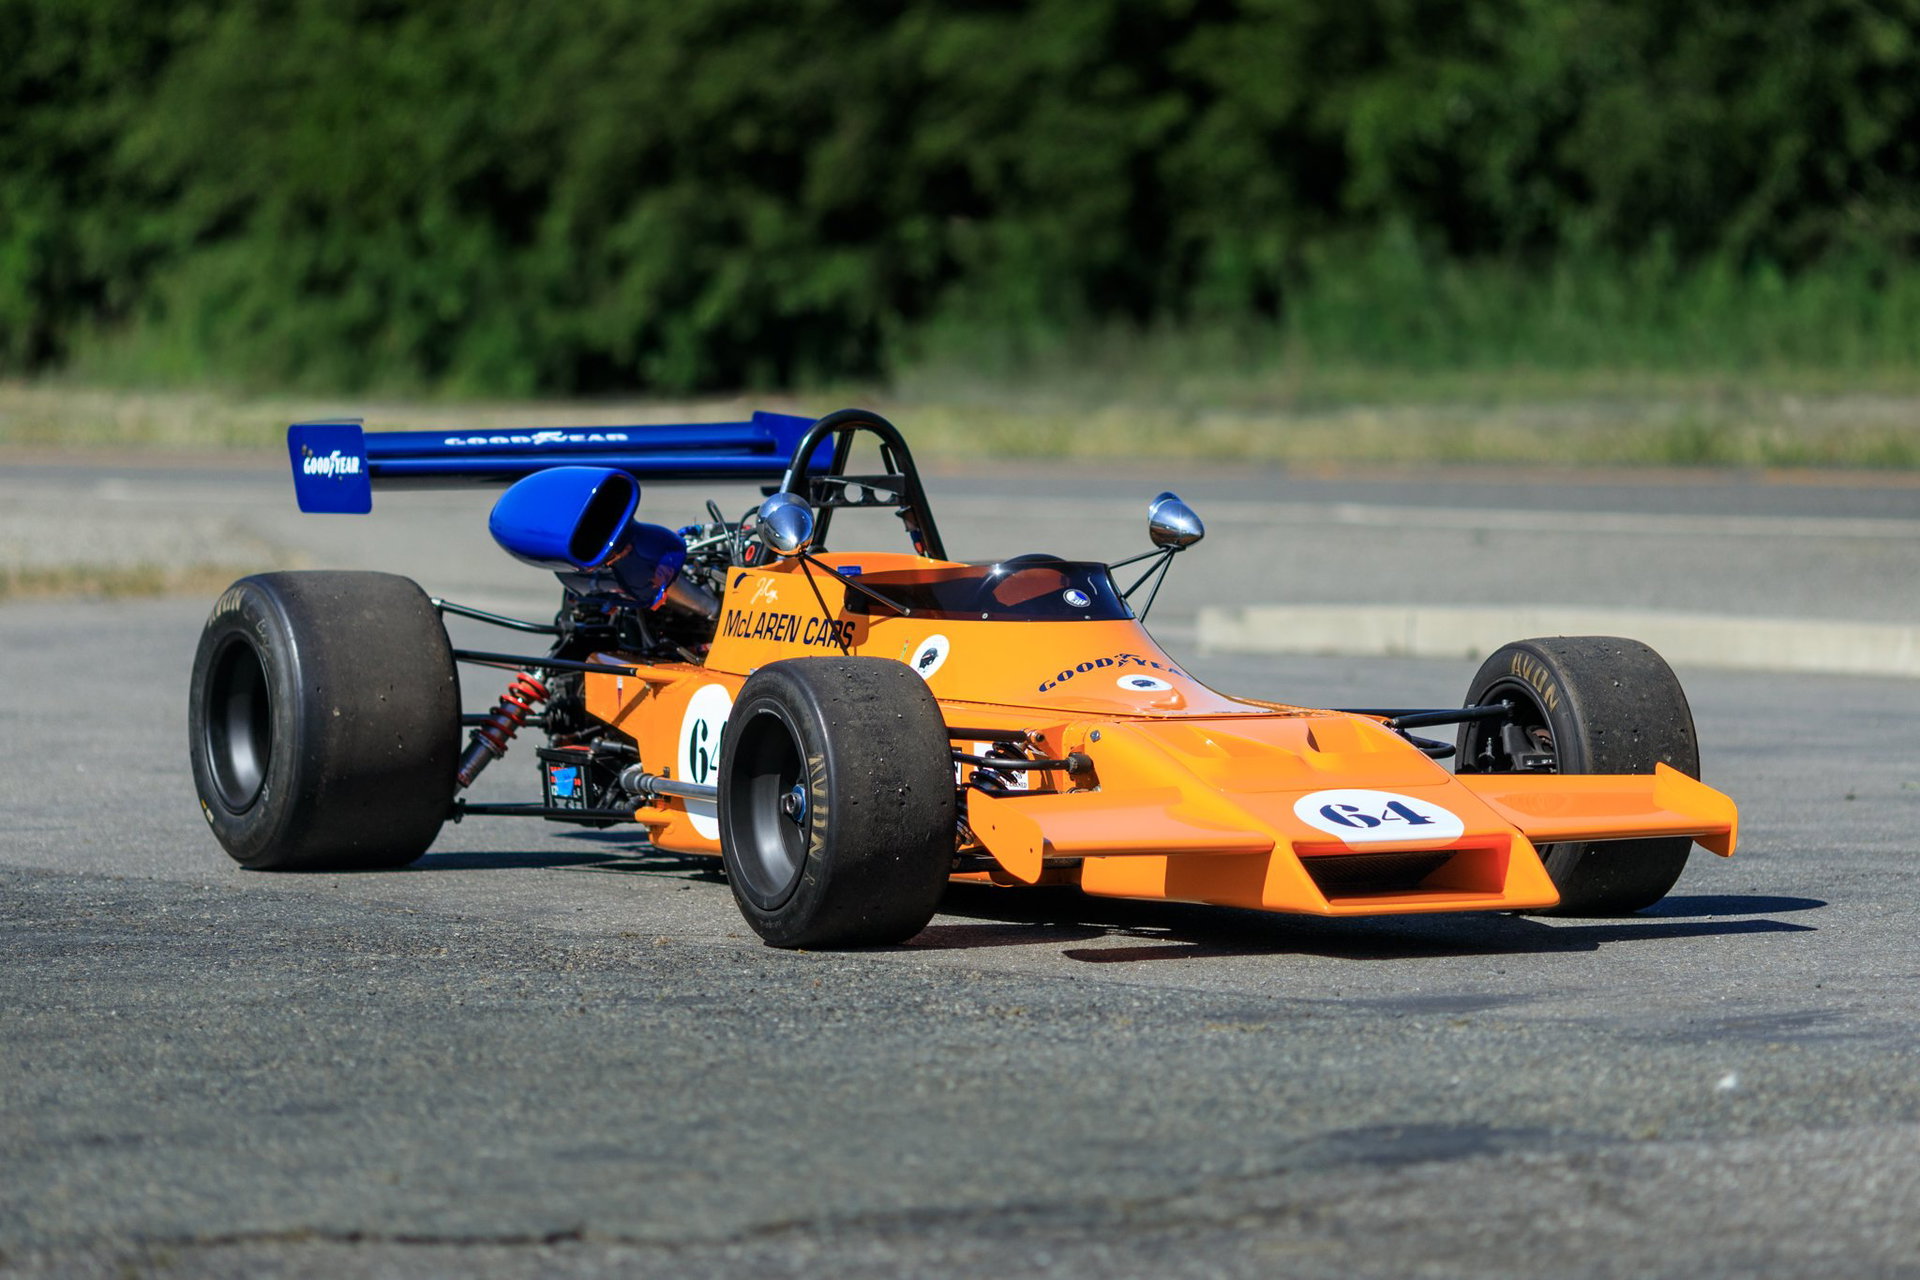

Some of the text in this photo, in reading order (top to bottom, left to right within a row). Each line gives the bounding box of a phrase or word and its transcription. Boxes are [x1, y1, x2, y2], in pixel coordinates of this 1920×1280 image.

[444, 431, 628, 445] GOODYEAR
[303, 450, 360, 478] GOODYEAR
[722, 609, 856, 650] McLAREN CARS
[1039, 653, 1193, 692] GOODYEA
[1510, 653, 1559, 712] AVON
[807, 754, 829, 861] AVON
[1319, 800, 1436, 829] 64
